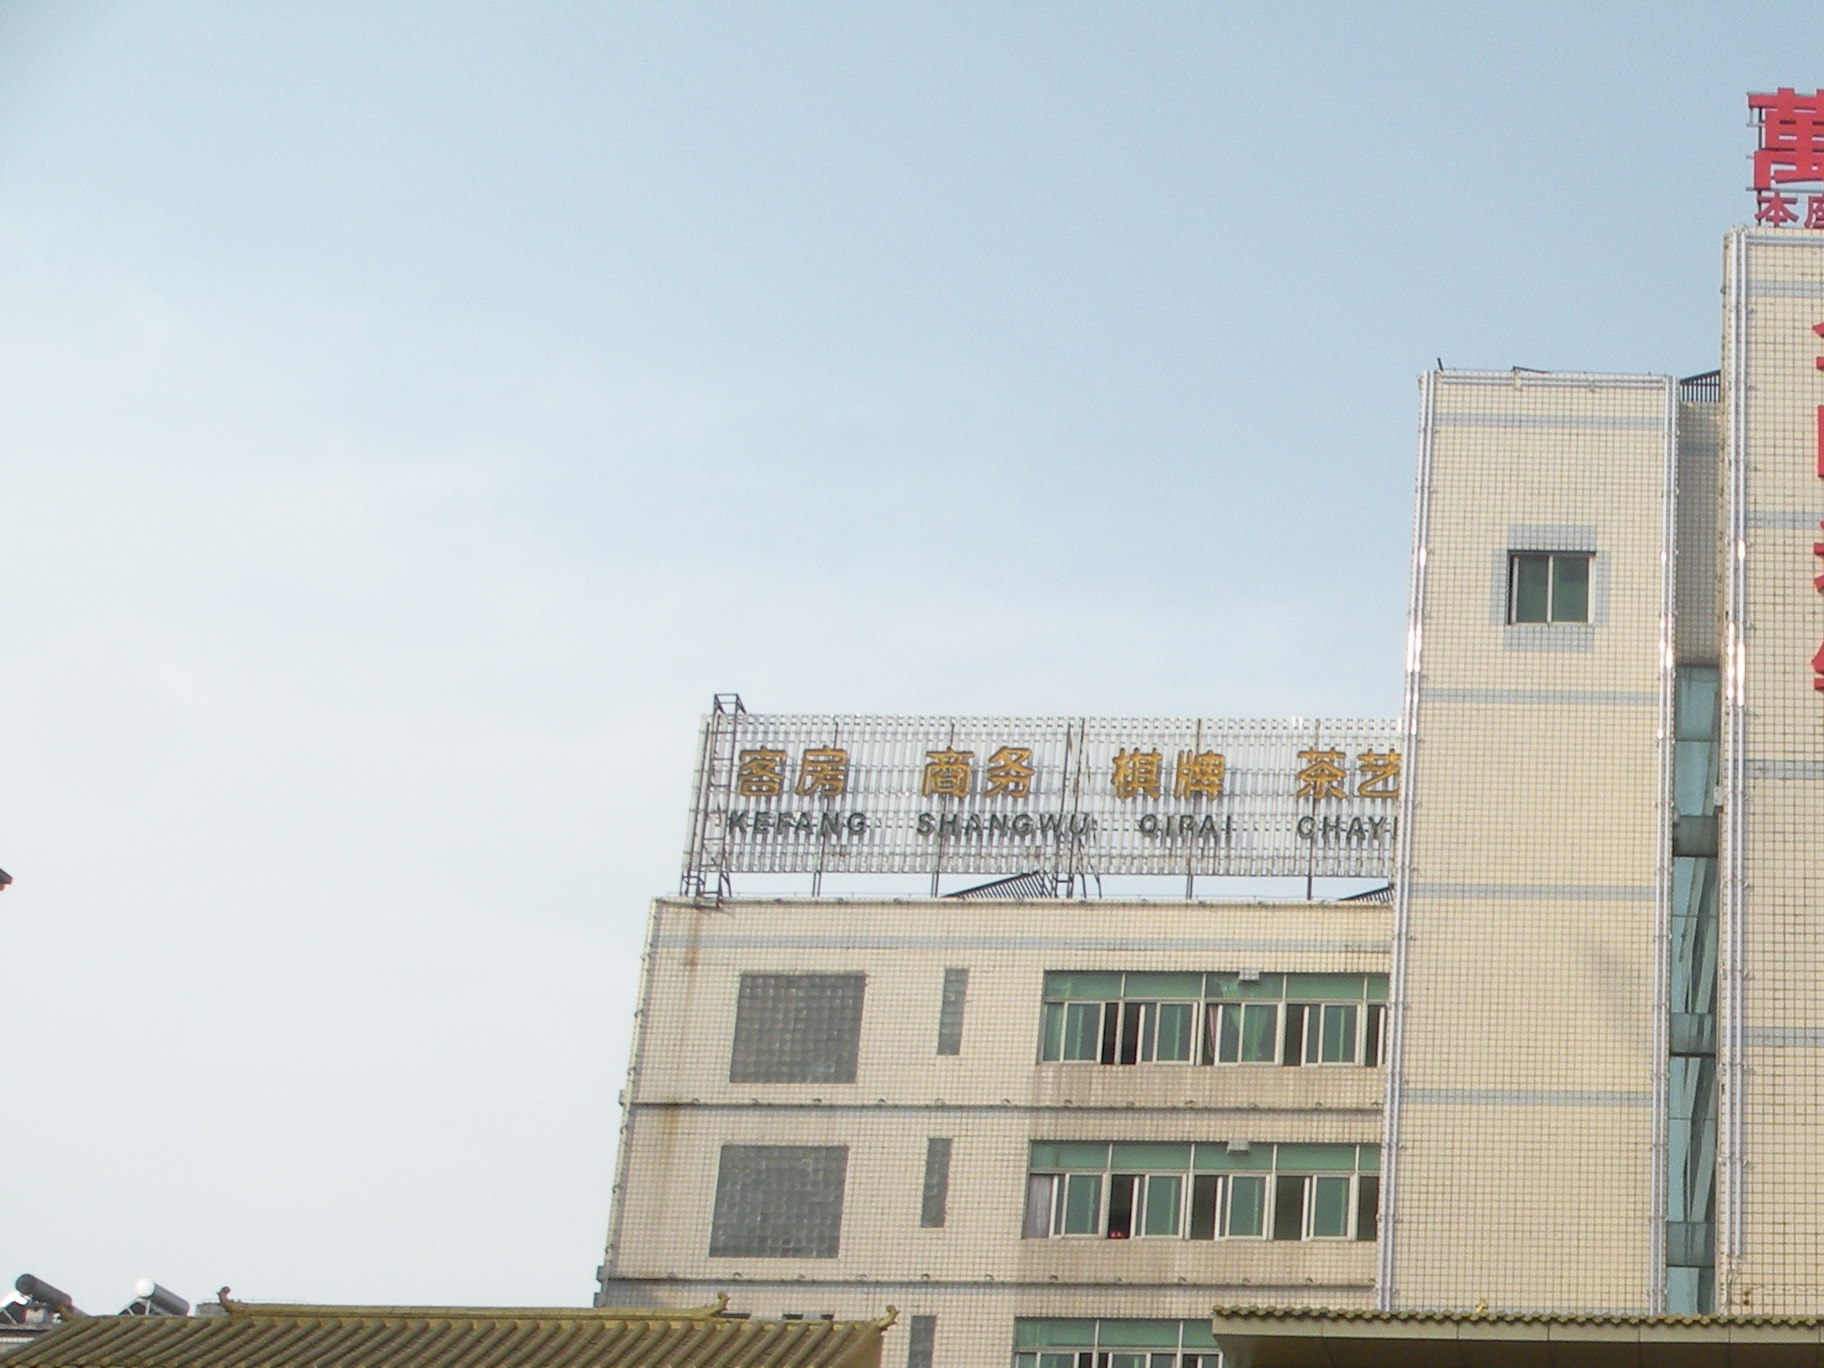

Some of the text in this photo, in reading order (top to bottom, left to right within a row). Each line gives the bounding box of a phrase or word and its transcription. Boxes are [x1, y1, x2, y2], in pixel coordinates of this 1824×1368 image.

[737, 745, 1401, 800] 客房 商务 棋牌 茶艺
[727, 810, 867, 837] KEFANG
[916, 810, 1091, 838] SHANGWU
[1140, 813, 1233, 839] QIPAI
